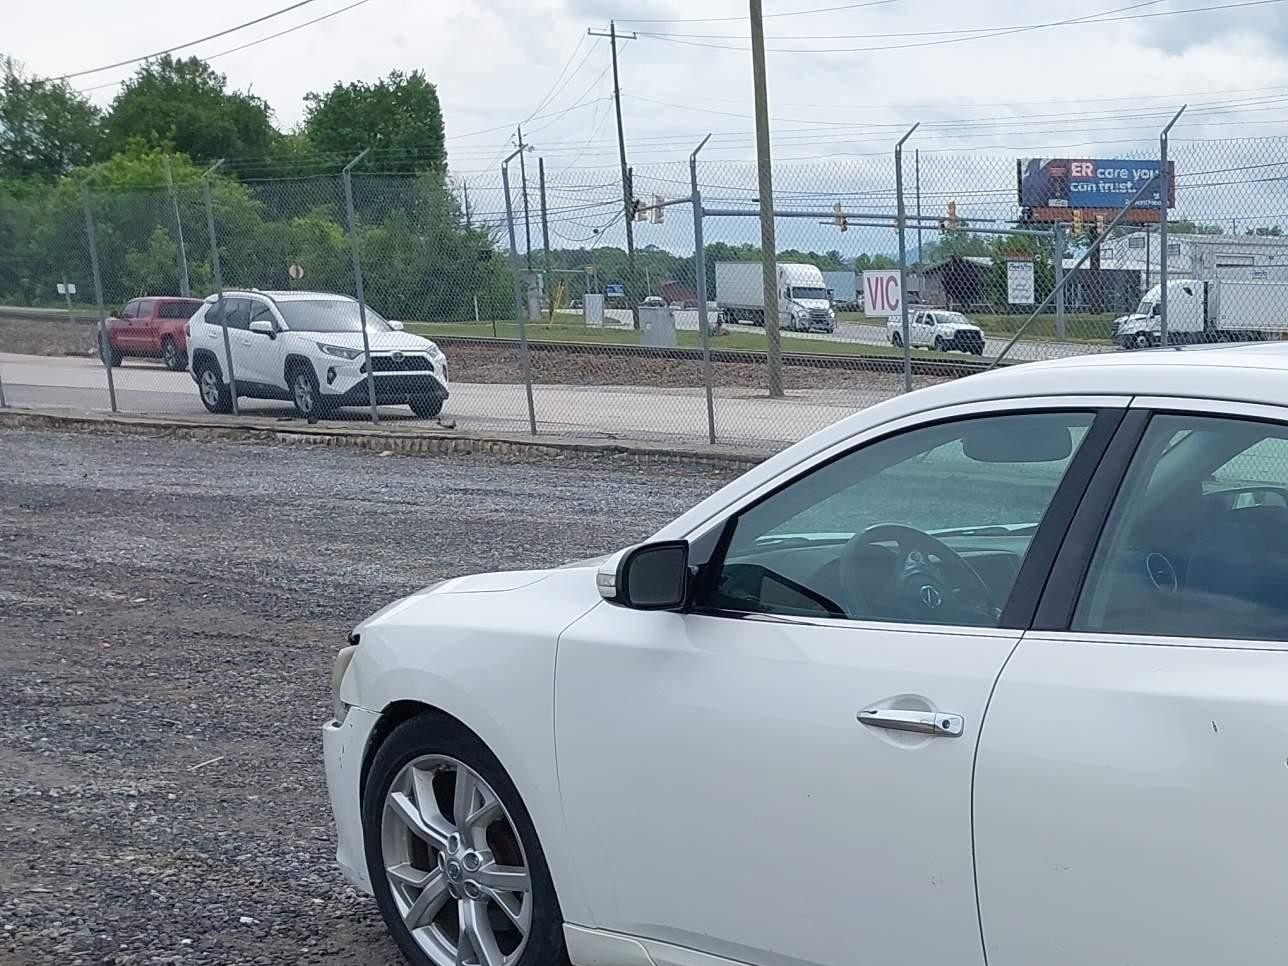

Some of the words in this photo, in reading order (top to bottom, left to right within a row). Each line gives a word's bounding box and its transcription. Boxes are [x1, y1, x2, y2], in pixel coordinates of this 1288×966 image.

[1071, 162, 1093, 177] ER
[1096, 168, 1129, 179] care
[1070, 182, 1096, 192] can
[1099, 180, 1137, 193] trust.
[866, 275, 900, 312] VIC
